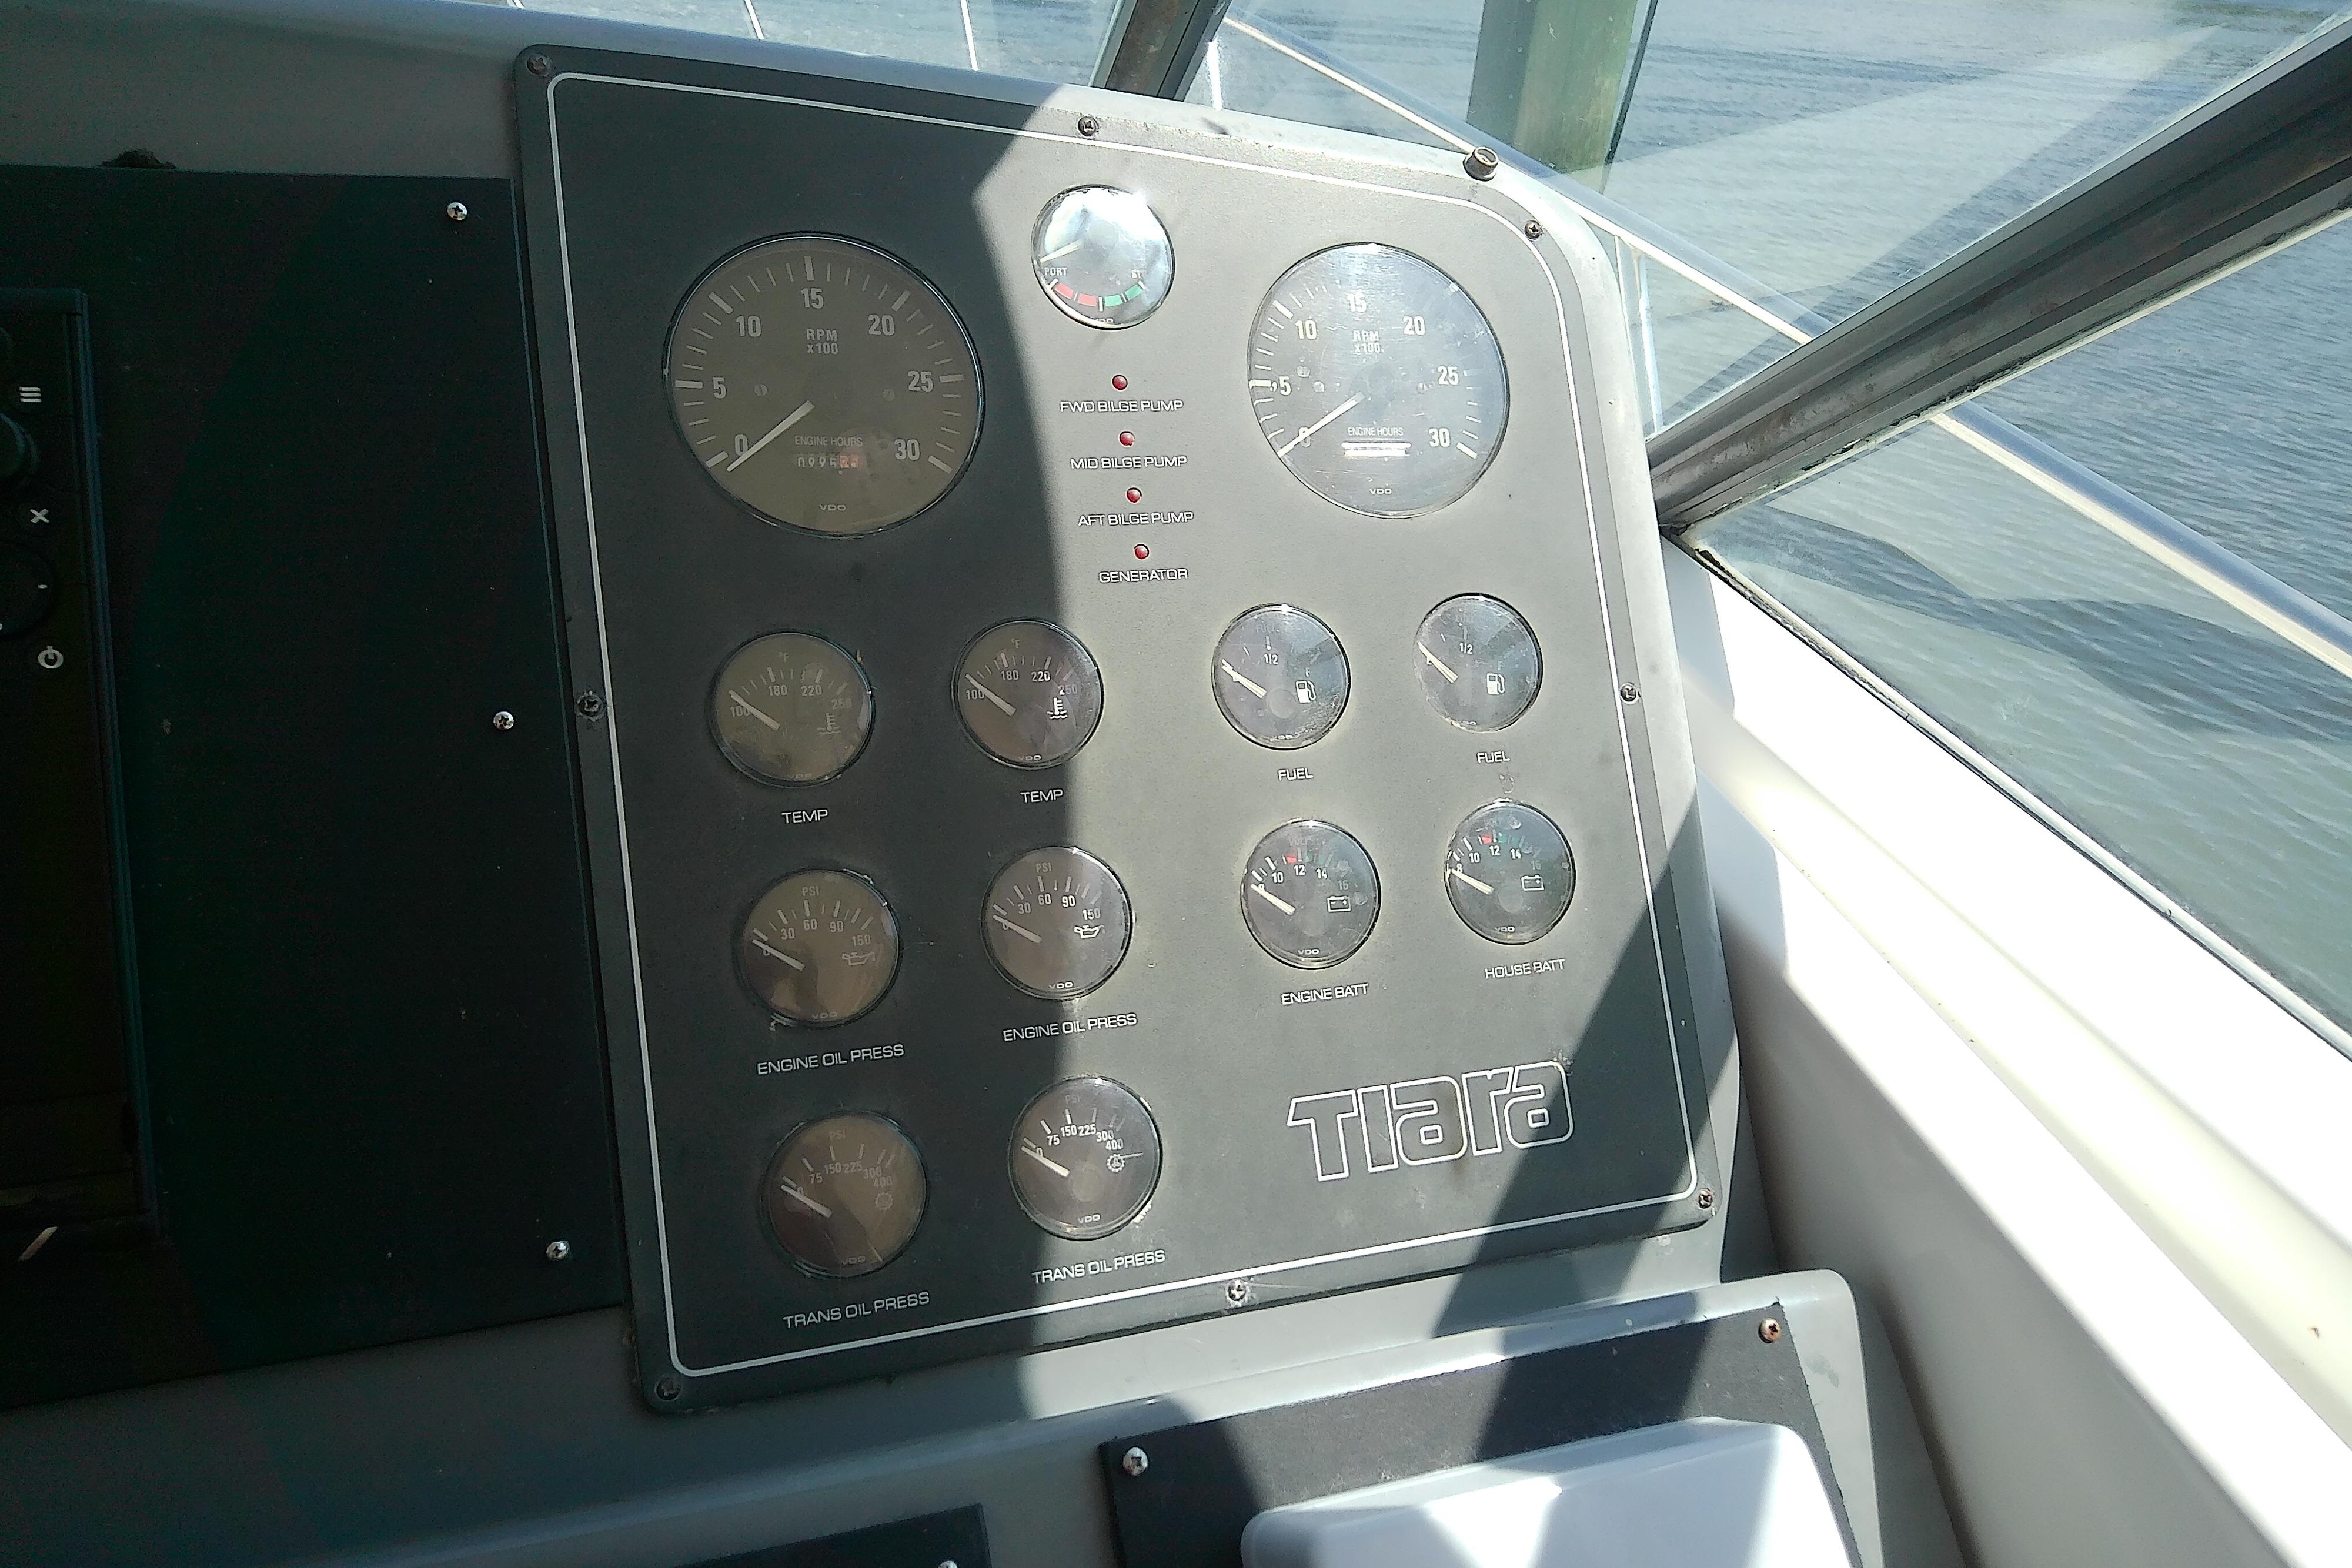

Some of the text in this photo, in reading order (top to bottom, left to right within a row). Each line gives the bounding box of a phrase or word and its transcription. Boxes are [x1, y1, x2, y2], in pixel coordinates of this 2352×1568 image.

[1044, 268, 1067, 276] PORT
[801, 288, 824, 309] 15
[1347, 293, 1367, 312] 15
[736, 316, 761, 337] 10
[868, 315, 895, 336] 20
[1295, 320, 1317, 339] 10
[1403, 316, 1425, 335] 20
[806, 329, 837, 342] RPM
[1352, 331, 1379, 342] RPM
[1438, 366, 1458, 385] 25
[713, 377, 726, 399] 5
[908, 371, 934, 393] 25
[1279, 376, 1291, 396] 5
[1060, 400, 1184, 412] FWD BILGE PUMP
[1348, 428, 1404, 436] ENGINE HOURS
[1429, 429, 1450, 447] 30
[734, 434, 749, 457] 0
[794, 436, 863, 447] ENGINE HOURS
[894, 439, 920, 460] 30
[1070, 456, 1187, 469] MID BILGE PUMP
[1078, 511, 1194, 526] AFT BILGE PUMP
[1099, 568, 1188, 583] GENERATOR
[1001, 670, 1019, 680] 180
[1031, 671, 1050, 682] 220
[768, 685, 788, 696] 180
[801, 685, 823, 696] 220
[966, 689, 985, 700] 100
[1059, 684, 1078, 695] 250
[730, 706, 750, 717] 100
[1476, 751, 1510, 763] FUEL
[1278, 767, 1313, 781] FUEL
[1020, 789, 1063, 803] TEMP
[781, 809, 828, 823] TEMP
[1489, 845, 1501, 856] 12
[1511, 848, 1521, 860] 14
[1469, 852, 1480, 863] 10
[1036, 862, 1052, 872] PSI
[1294, 864, 1306, 875] 12
[1531, 860, 1541, 870] 16
[1272, 872, 1284, 883] 10
[1316, 868, 1328, 879] 14
[801, 885, 820, 897] PSI
[1338, 881, 1348, 890] 16
[1038, 893, 1051, 905] 60
[1062, 895, 1076, 907] 90
[1018, 902, 1031, 914] 30
[1082, 908, 1101, 920] 150
[803, 918, 818, 931] 60
[830, 920, 844, 932] 90
[780, 927, 796, 940] 30
[851, 934, 871, 946] 150
[1485, 959, 1565, 979] HOUSE BATT
[1049, 981, 1073, 989] VDO
[1281, 983, 1368, 1005] ENGINE BATT
[1003, 1012, 1137, 1042] ENGINE OIL PRESS
[757, 1044, 904, 1075] ENGINE OIL PRESS
[830, 1129, 846, 1140] PSI
[1060, 1125, 1077, 1137] 150
[1078, 1124, 1096, 1136] 225
[1096, 1130, 1114, 1142] 300
[1047, 1135, 1060, 1146] 75
[1105, 1138, 1124, 1151] 400
[824, 1162, 841, 1174] 150
[843, 1162, 863, 1174] 225
[810, 1174, 823, 1184] 75
[1077, 1214, 1101, 1224] VDO
[1031, 1249, 1165, 1284] TRANS OIL PRESS
[783, 1292, 930, 1329] TRANS OIL PRESS
